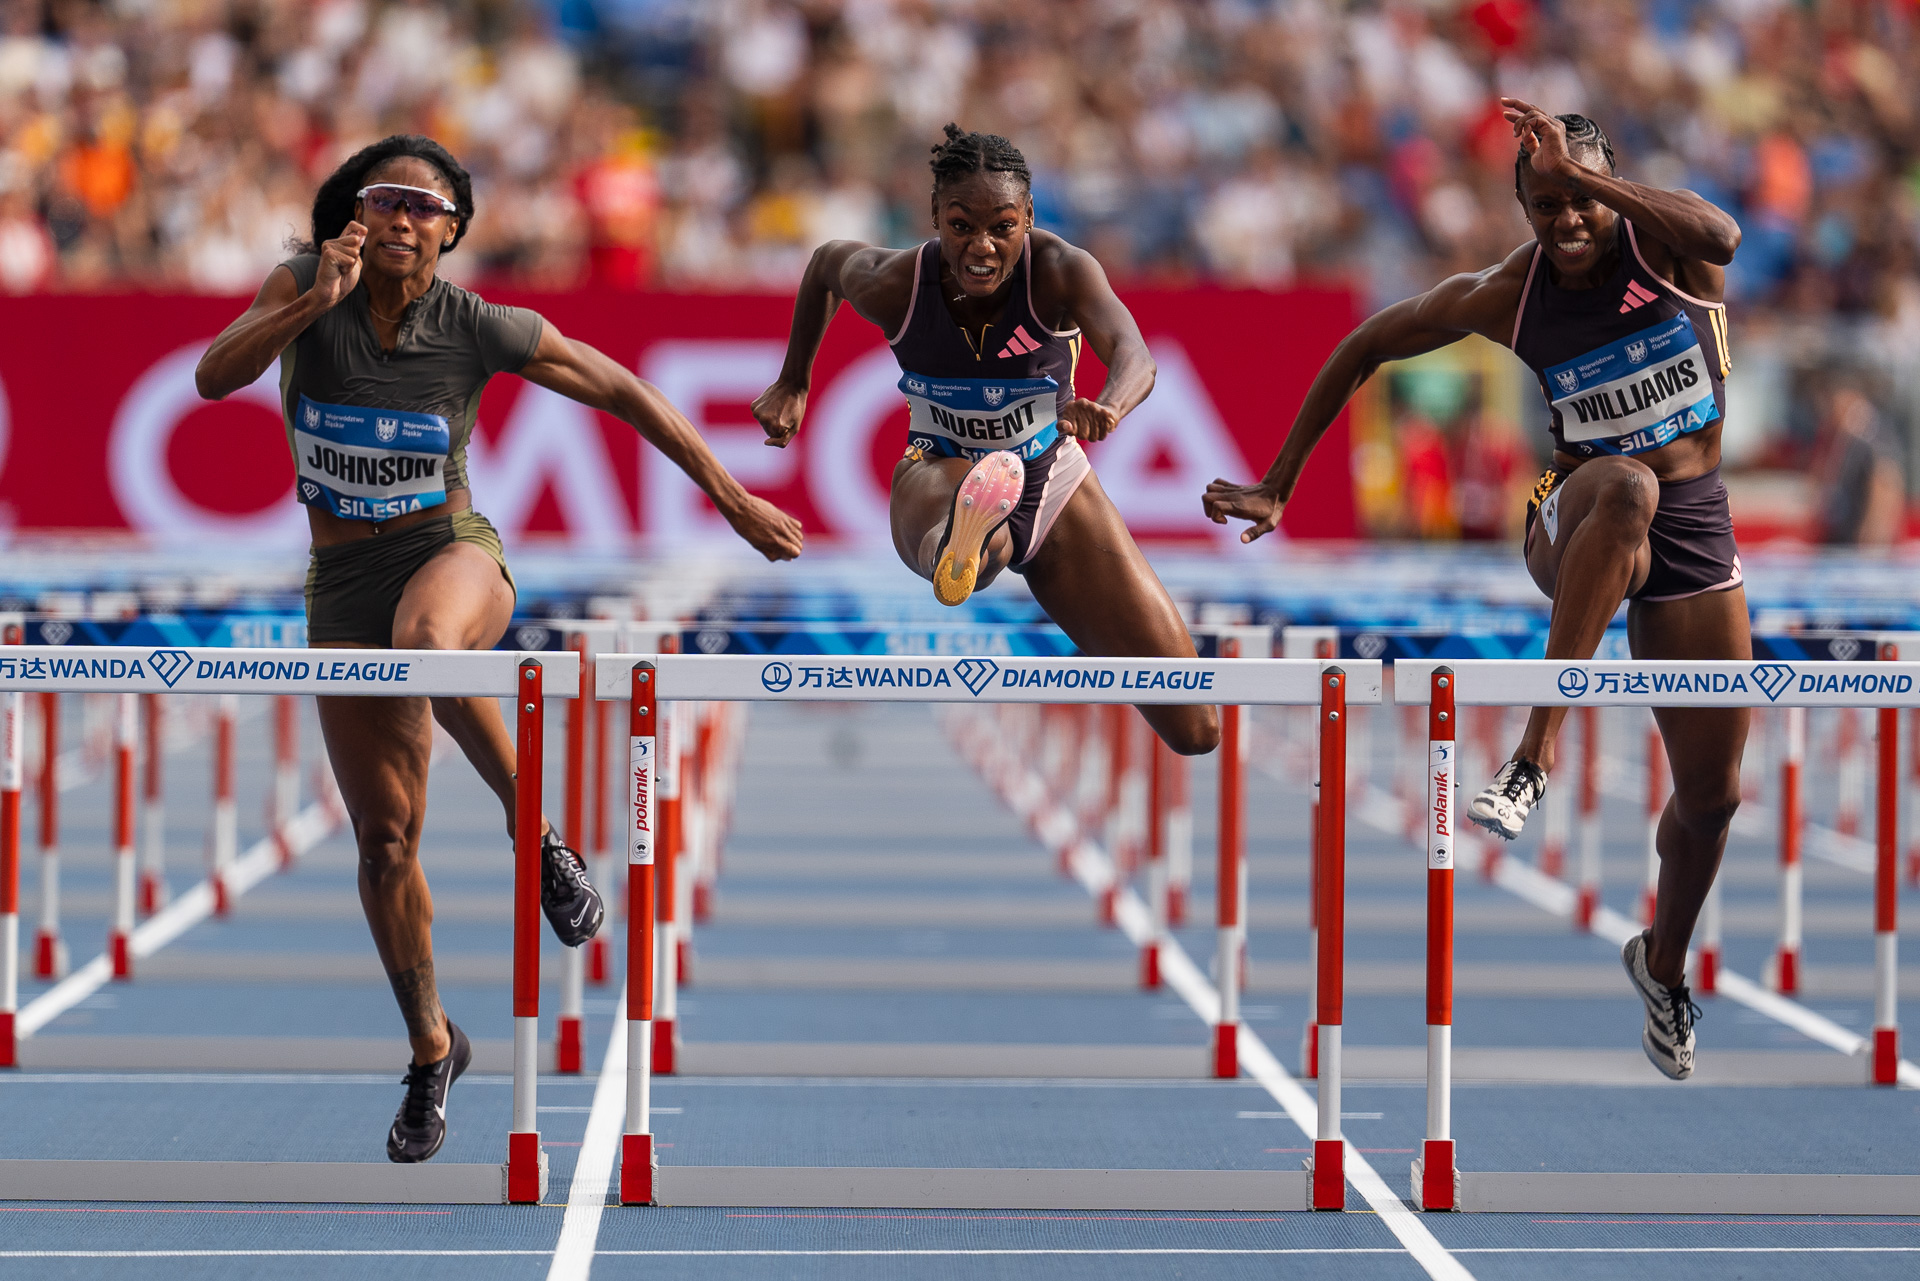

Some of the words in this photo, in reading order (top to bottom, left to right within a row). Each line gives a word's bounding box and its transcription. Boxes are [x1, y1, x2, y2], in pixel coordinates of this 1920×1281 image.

[1569, 358, 1698, 424] WILLIAMS
[928, 400, 1036, 440] NUGENT
[1619, 410, 1702, 452] SILESIA
[307, 444, 438, 486] JOHNSON
[339, 498, 423, 519] SILESIA
[196, 660, 310, 681] DIAMOND
[316, 662, 411, 682] LEAGUE
[1002, 669, 1115, 689] DIAMOND
[1121, 671, 1216, 690] LEAGUE
[1798, 674, 1913, 694] DIAMOND
[633, 766, 650, 832] polanik
[1433, 770, 1450, 837] polanik
[1677, 1050, 1692, 1076] Y-3
